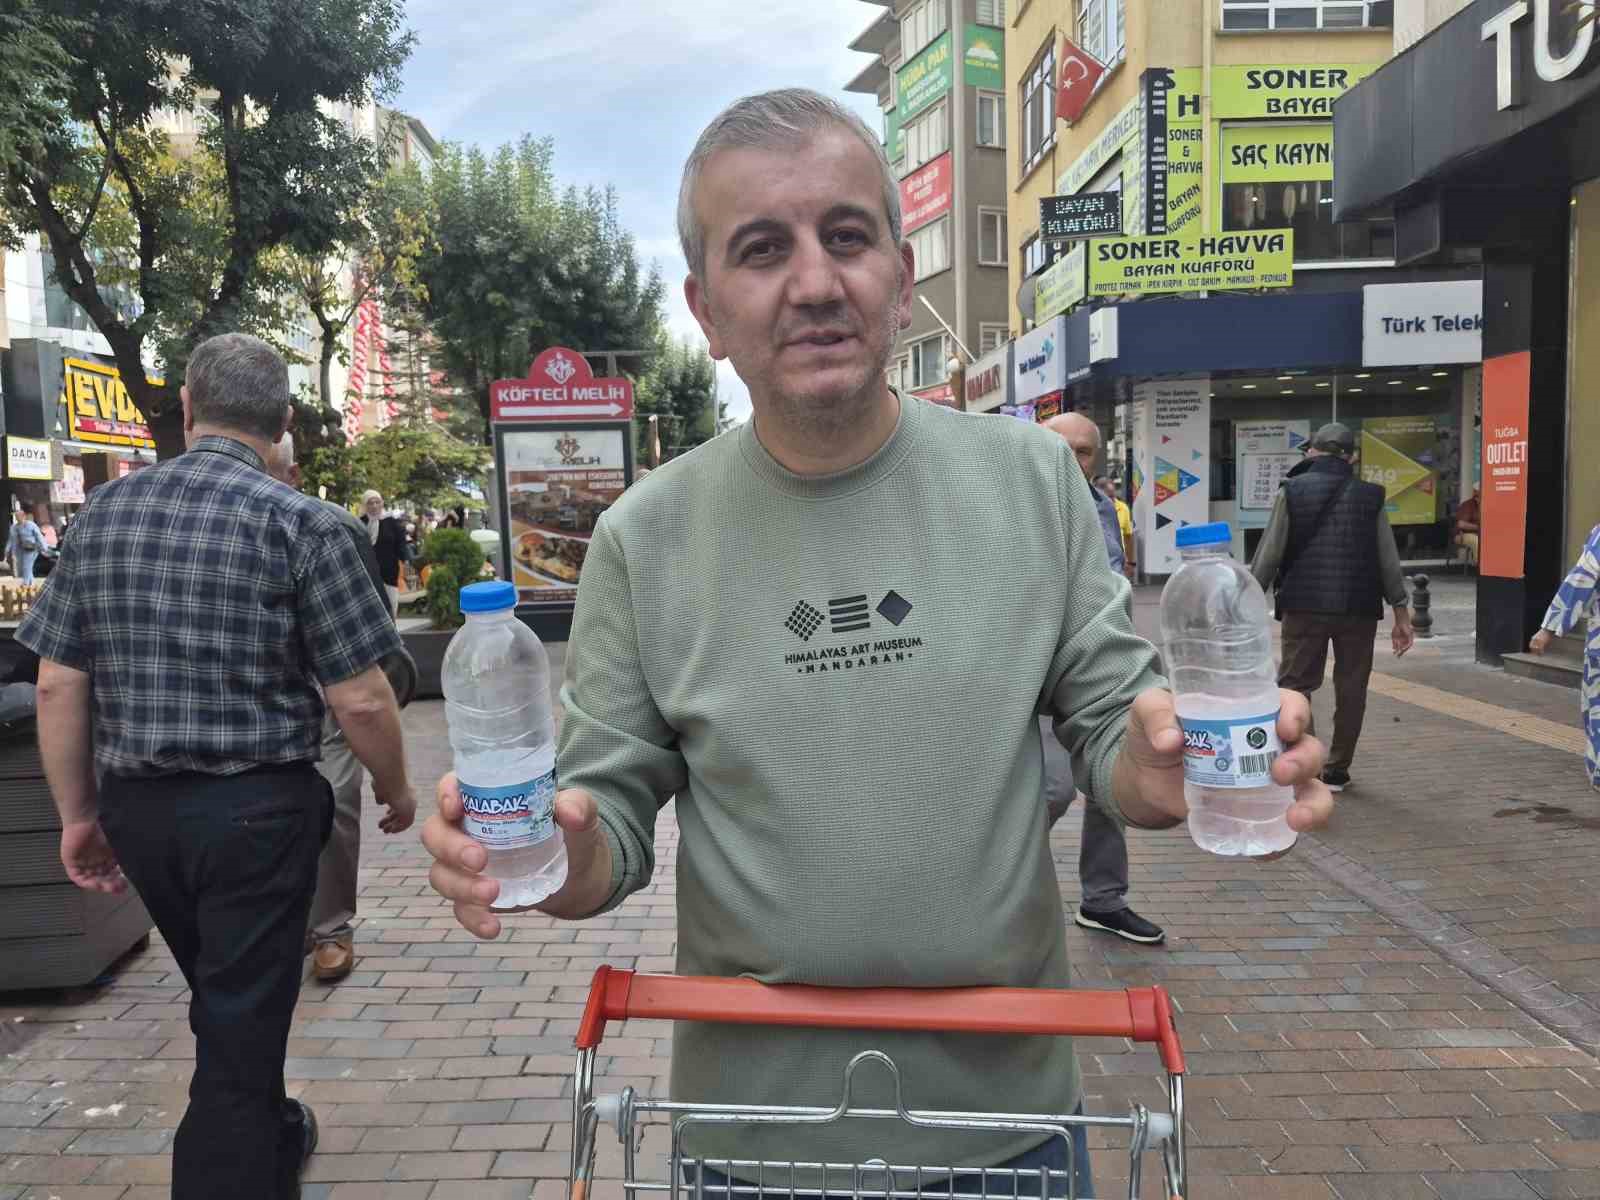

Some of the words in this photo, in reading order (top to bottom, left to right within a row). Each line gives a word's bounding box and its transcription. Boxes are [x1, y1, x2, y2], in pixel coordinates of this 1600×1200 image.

[1246, 69, 1348, 90] SONER
[1169, 128, 1203, 142] SONER
[1182, 145, 1191, 157] &
[1231, 144, 1268, 169] SAÇ
[1055, 197, 1105, 214] BAYAN
[1169, 184, 1200, 211] BAYAN
[1098, 240, 1181, 261] SONER
[1200, 233, 1285, 257] HAVVA
[1124, 263, 1175, 277] BAYAN
[1382, 316, 1426, 335] Türk
[498, 384, 568, 402] KÖFTECİ
[572, 383, 625, 400] MELİH
[12, 447, 47, 460] DADYA
[1487, 441, 1527, 464] OUTLET
[785, 646, 848, 664] HIMALAYAS
[851, 643, 871, 656] ART
[874, 637, 922, 652] MUSEUM
